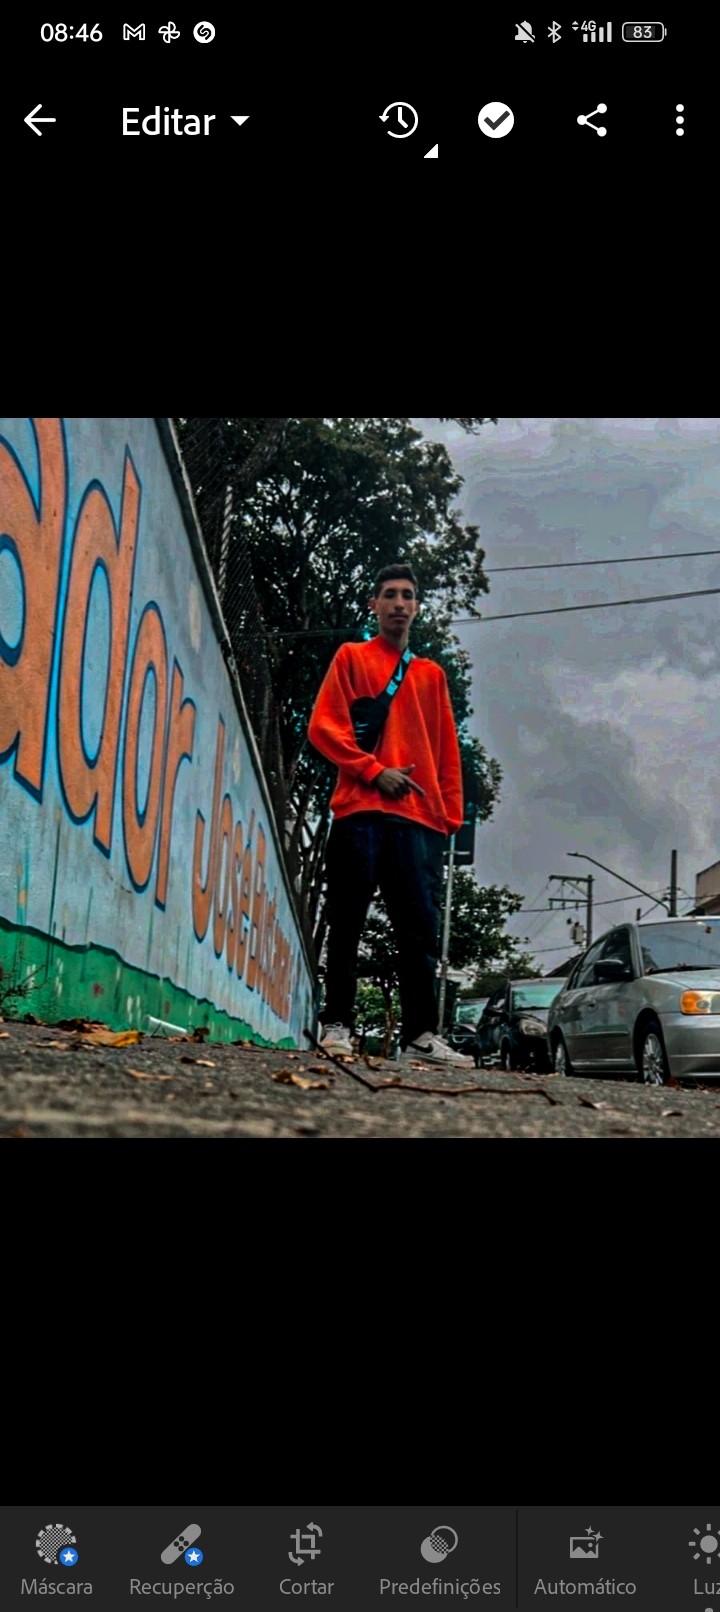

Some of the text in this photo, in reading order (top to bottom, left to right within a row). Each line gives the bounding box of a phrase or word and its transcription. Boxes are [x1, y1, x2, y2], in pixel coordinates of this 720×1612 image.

[41, 23, 103, 42] 08:46
[581, 20, 597, 32] 4G
[633, 26, 653, 38] 83
[123, 106, 216, 136] Editar
[20, 1578, 93, 1595] Máscara
[130, 1578, 235, 1599] Recuperção
[280, 1578, 335, 1595] Cortar
[380, 1577, 502, 1600] Predefinições
[534, 1577, 637, 1595] Automático
